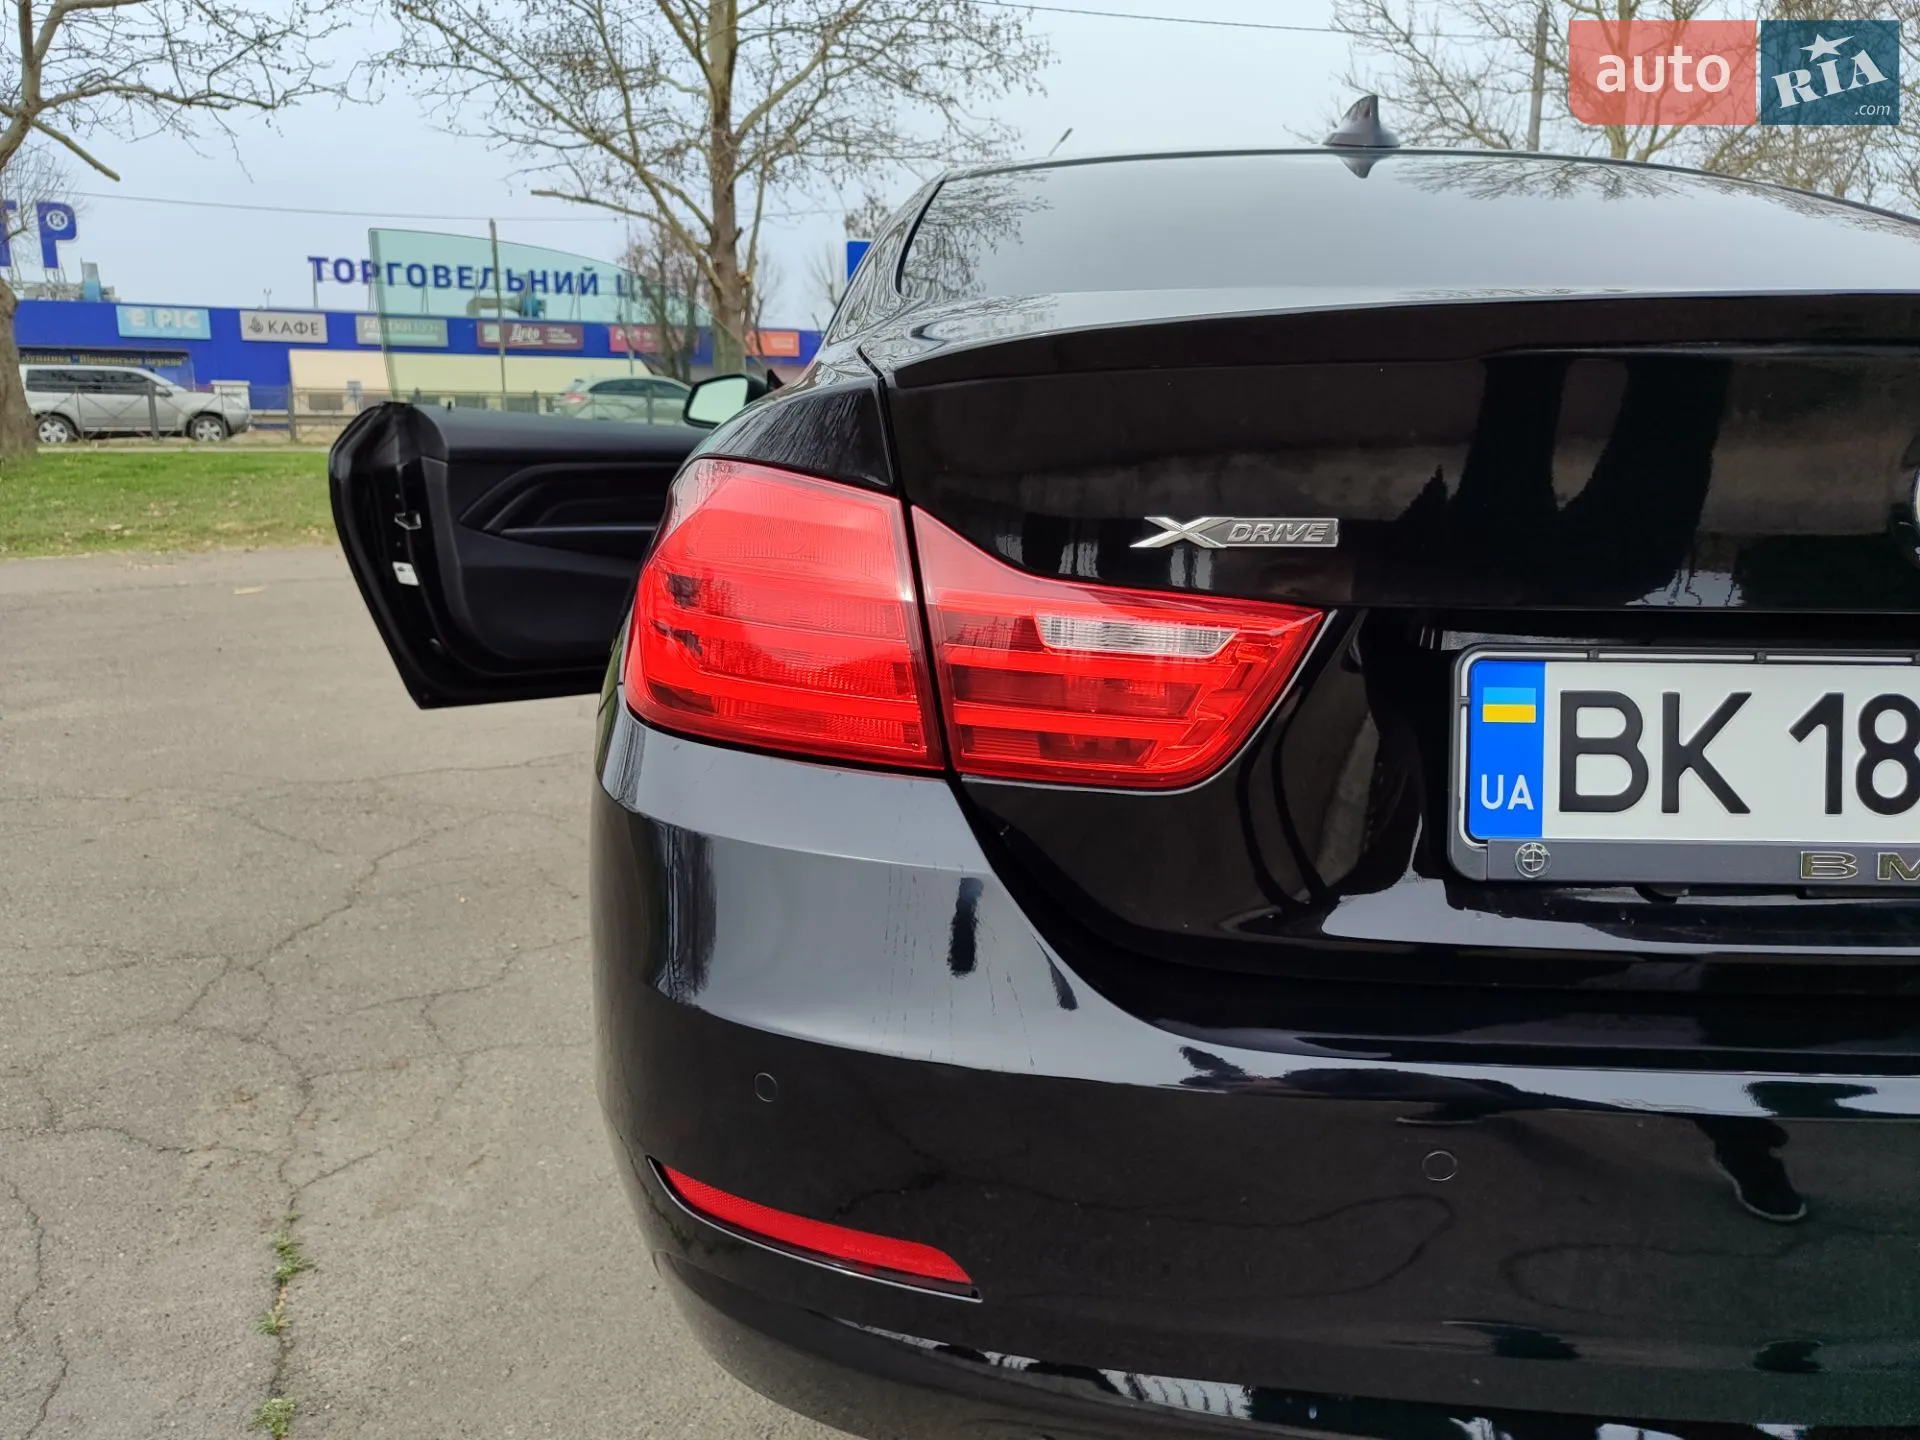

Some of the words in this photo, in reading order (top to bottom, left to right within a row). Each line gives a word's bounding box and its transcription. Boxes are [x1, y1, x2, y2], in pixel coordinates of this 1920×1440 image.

[308, 256, 599, 296] ТОРГОВЕЛЬНИЙ
[268, 319, 319, 336] КАФЕ
[1560, 690, 1752, 814] BK
[1788, 692, 1920, 815] 18
[1481, 774, 1534, 810] UA
